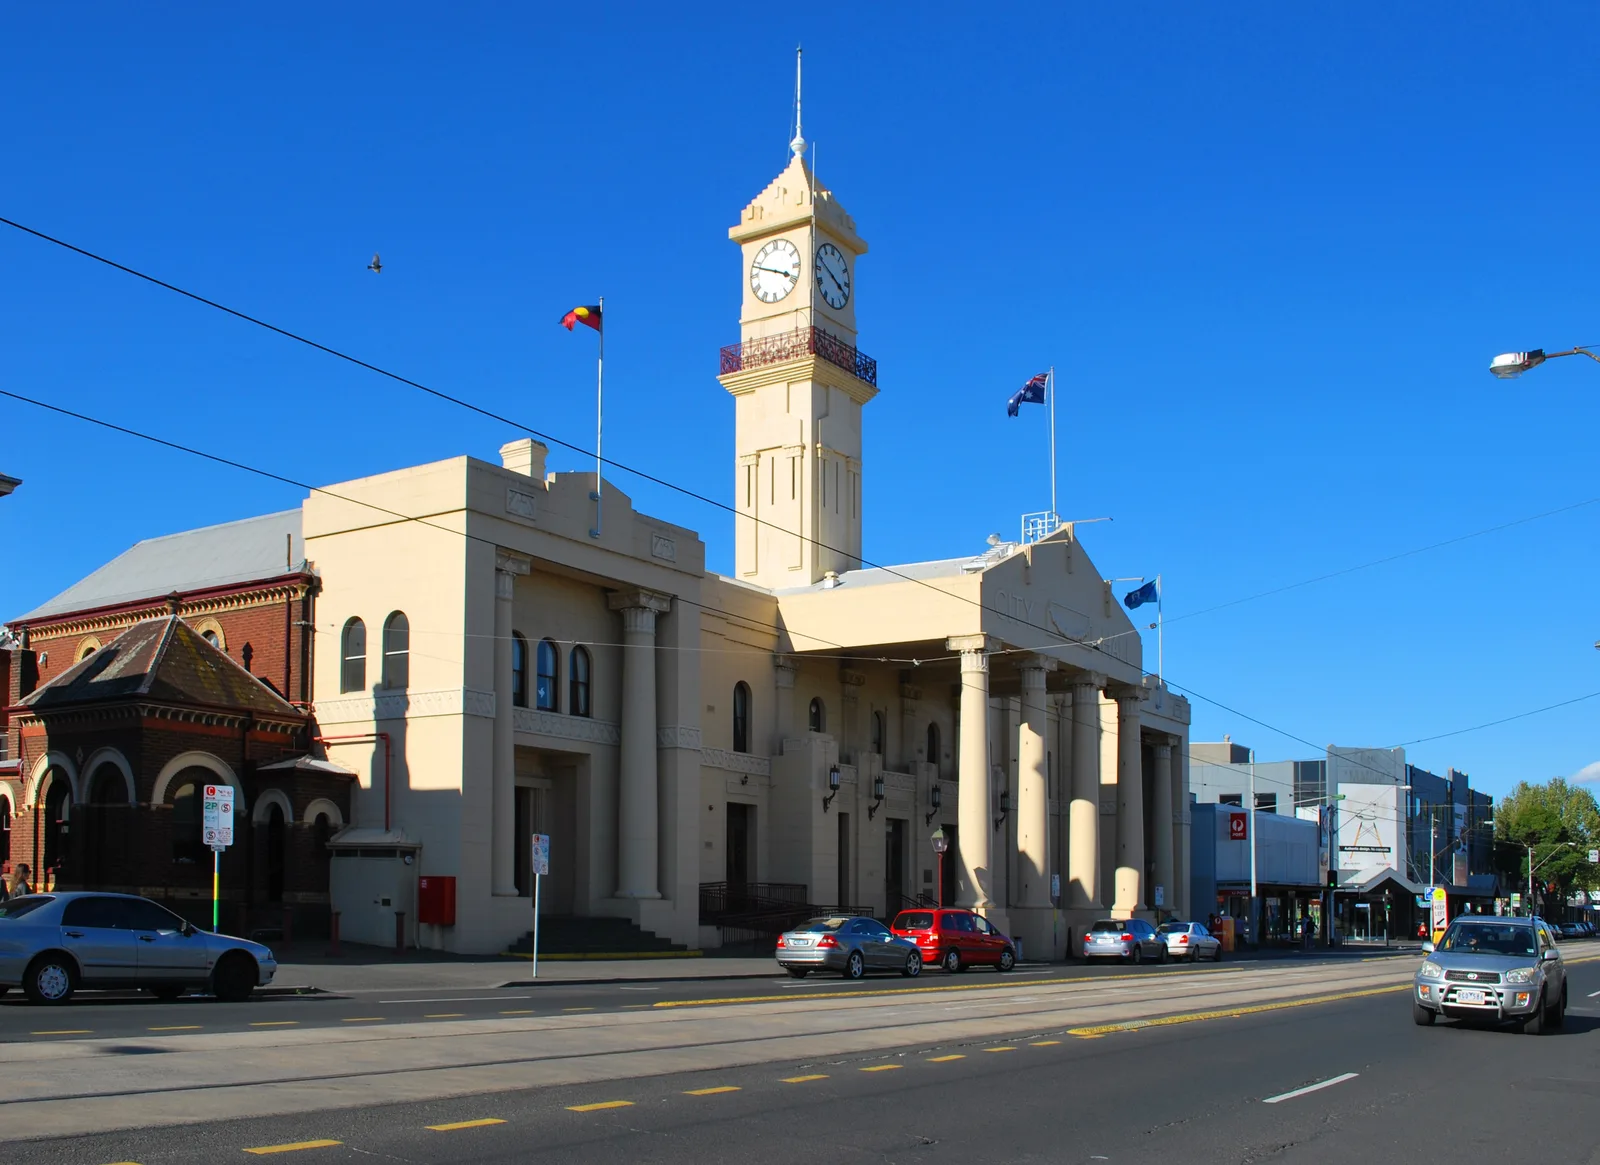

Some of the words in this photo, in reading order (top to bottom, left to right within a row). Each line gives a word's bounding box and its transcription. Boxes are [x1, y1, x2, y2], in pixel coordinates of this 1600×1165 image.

[995, 589, 1035, 626] CITY
[1101, 626, 1141, 667] HAL
[205, 802, 218, 810] 2P
